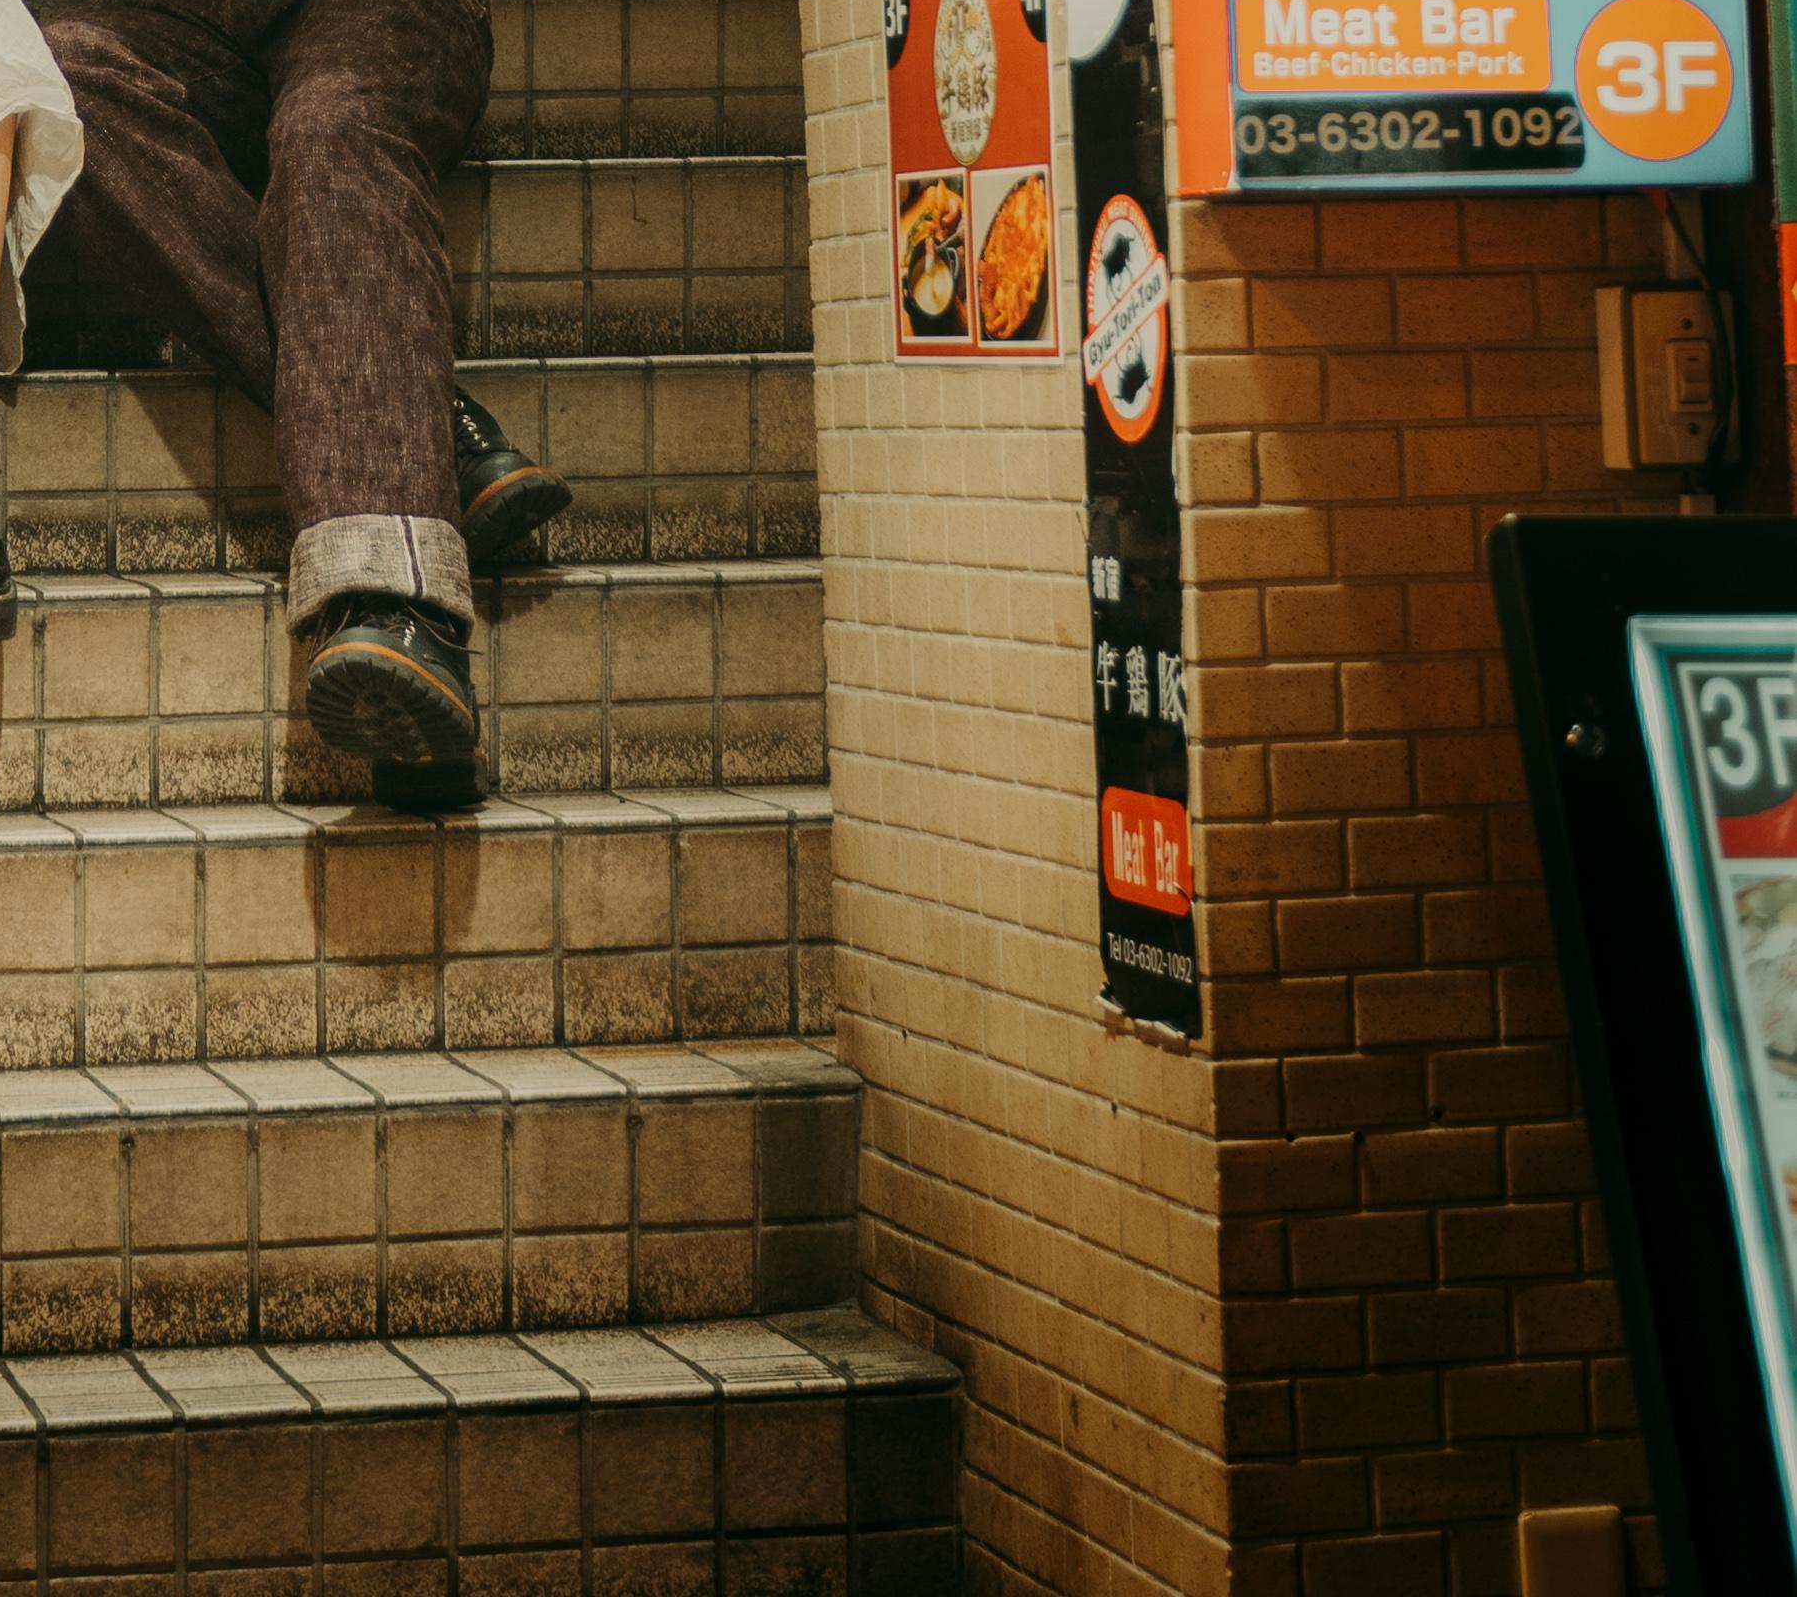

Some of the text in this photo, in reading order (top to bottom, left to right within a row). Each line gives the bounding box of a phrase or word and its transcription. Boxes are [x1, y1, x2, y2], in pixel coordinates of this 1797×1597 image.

[1596, 39, 1718, 114] 3F
[1237, 106, 1584, 155] 03-6302-1092
[1092, 555, 1121, 601] 新宿
[1096, 640, 1187, 729] 牛鶏豚
[1111, 810, 1180, 896] Meat Bar
[1107, 932, 1193, 985] Tel 03-6302-1092
